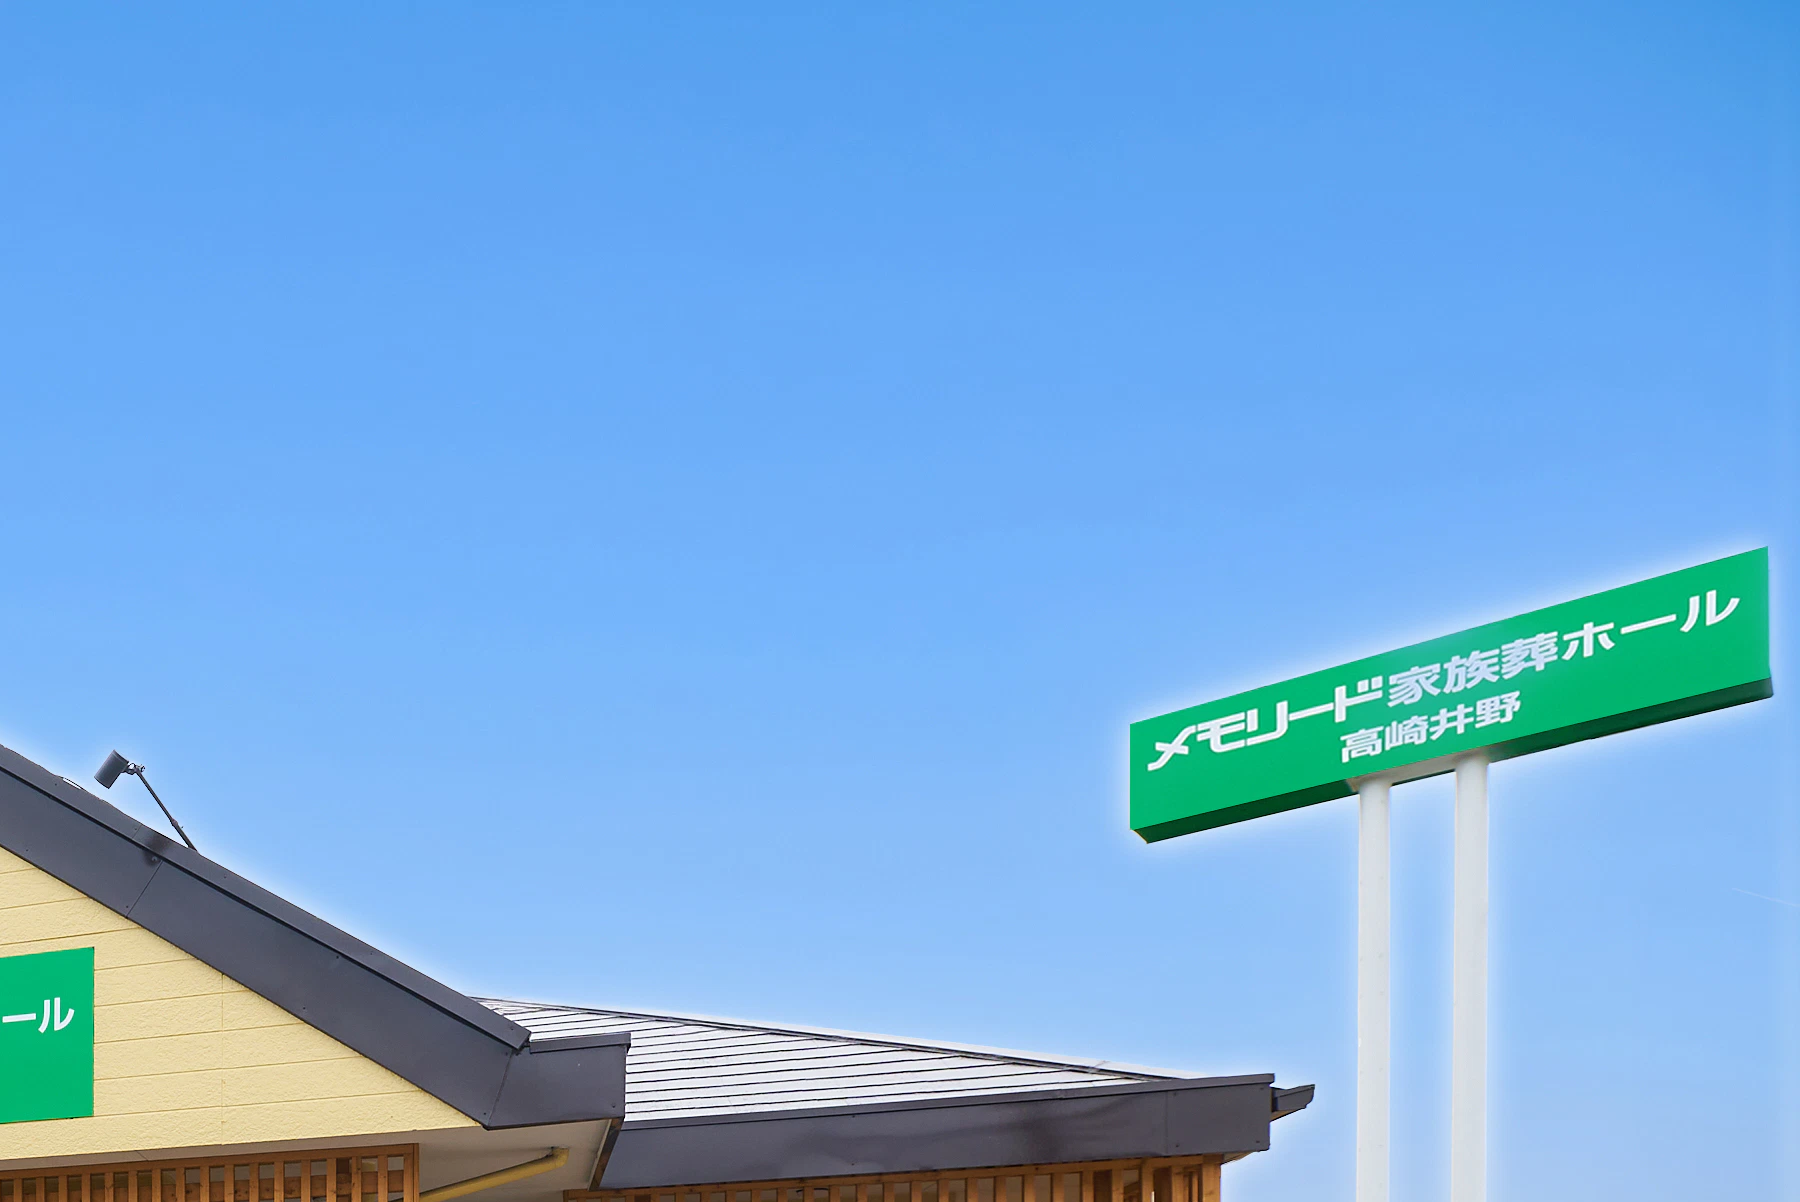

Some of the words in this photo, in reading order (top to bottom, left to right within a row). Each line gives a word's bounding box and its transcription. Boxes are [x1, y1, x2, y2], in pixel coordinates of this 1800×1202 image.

[1147, 589, 1740, 771] メモリード家族葬ホール
[1340, 691, 1521, 763] 高崎井野
